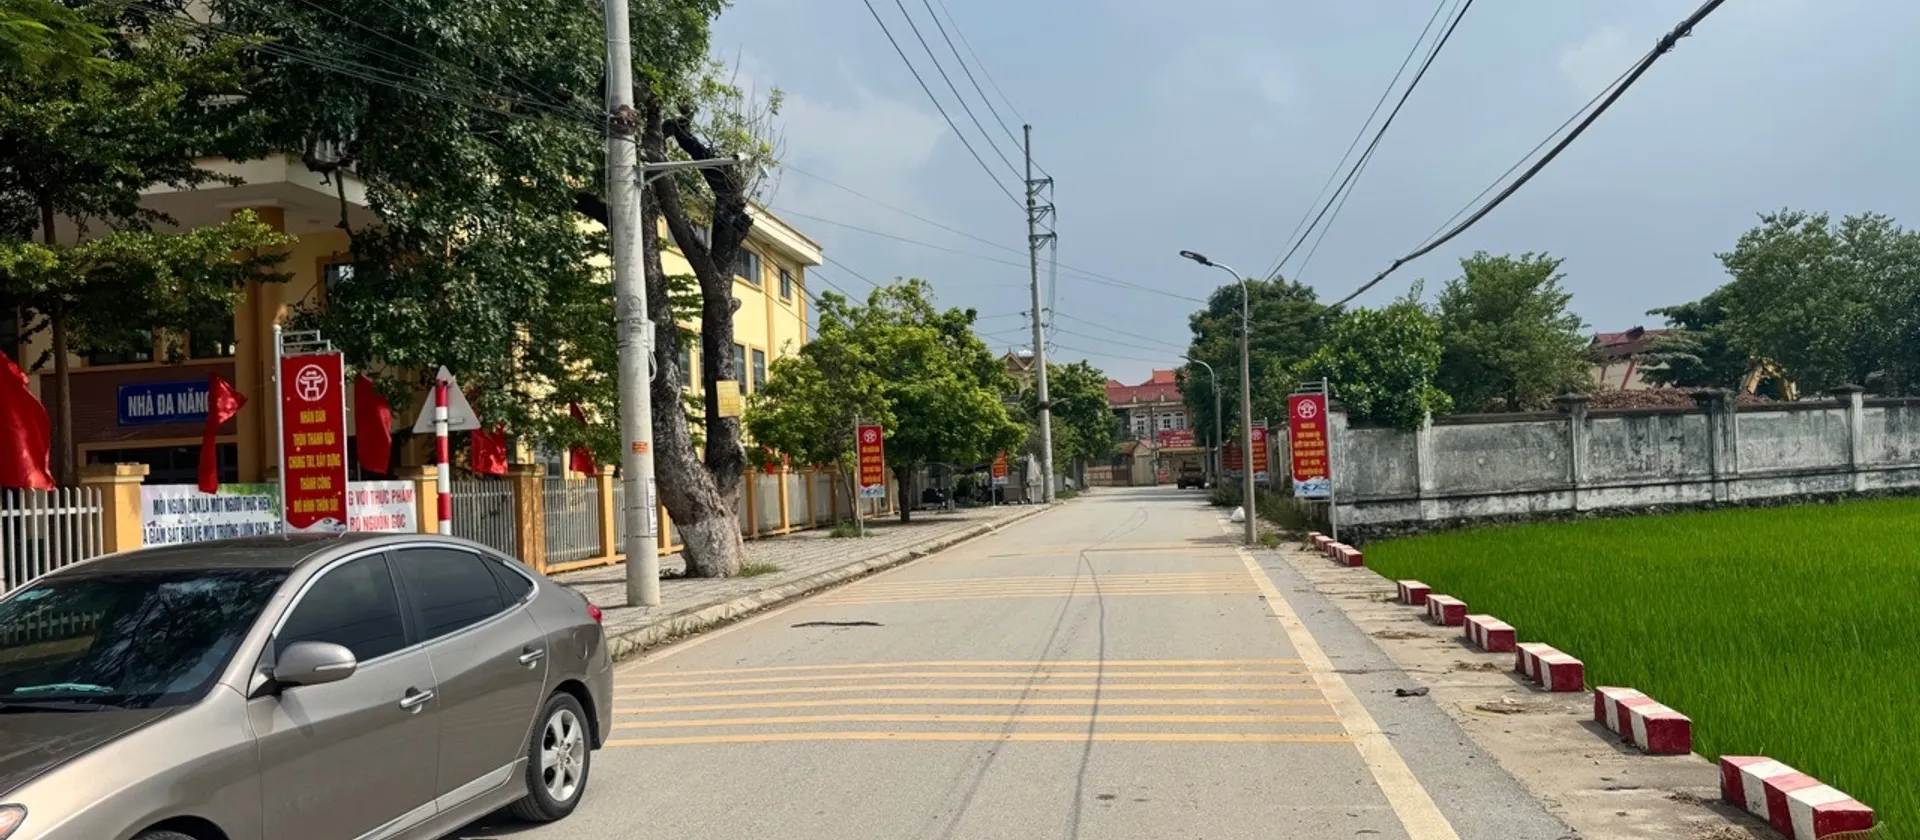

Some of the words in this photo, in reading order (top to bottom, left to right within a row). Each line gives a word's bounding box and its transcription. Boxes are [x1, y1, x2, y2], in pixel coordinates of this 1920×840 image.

[128, 390, 154, 416] NHÀ
[157, 393, 174, 415] ĐA
[370, 489, 390, 507] THỰC
[363, 512, 389, 531] NGUỒN
[391, 510, 406, 528] GỐC
[167, 523, 180, 542] SÁT
